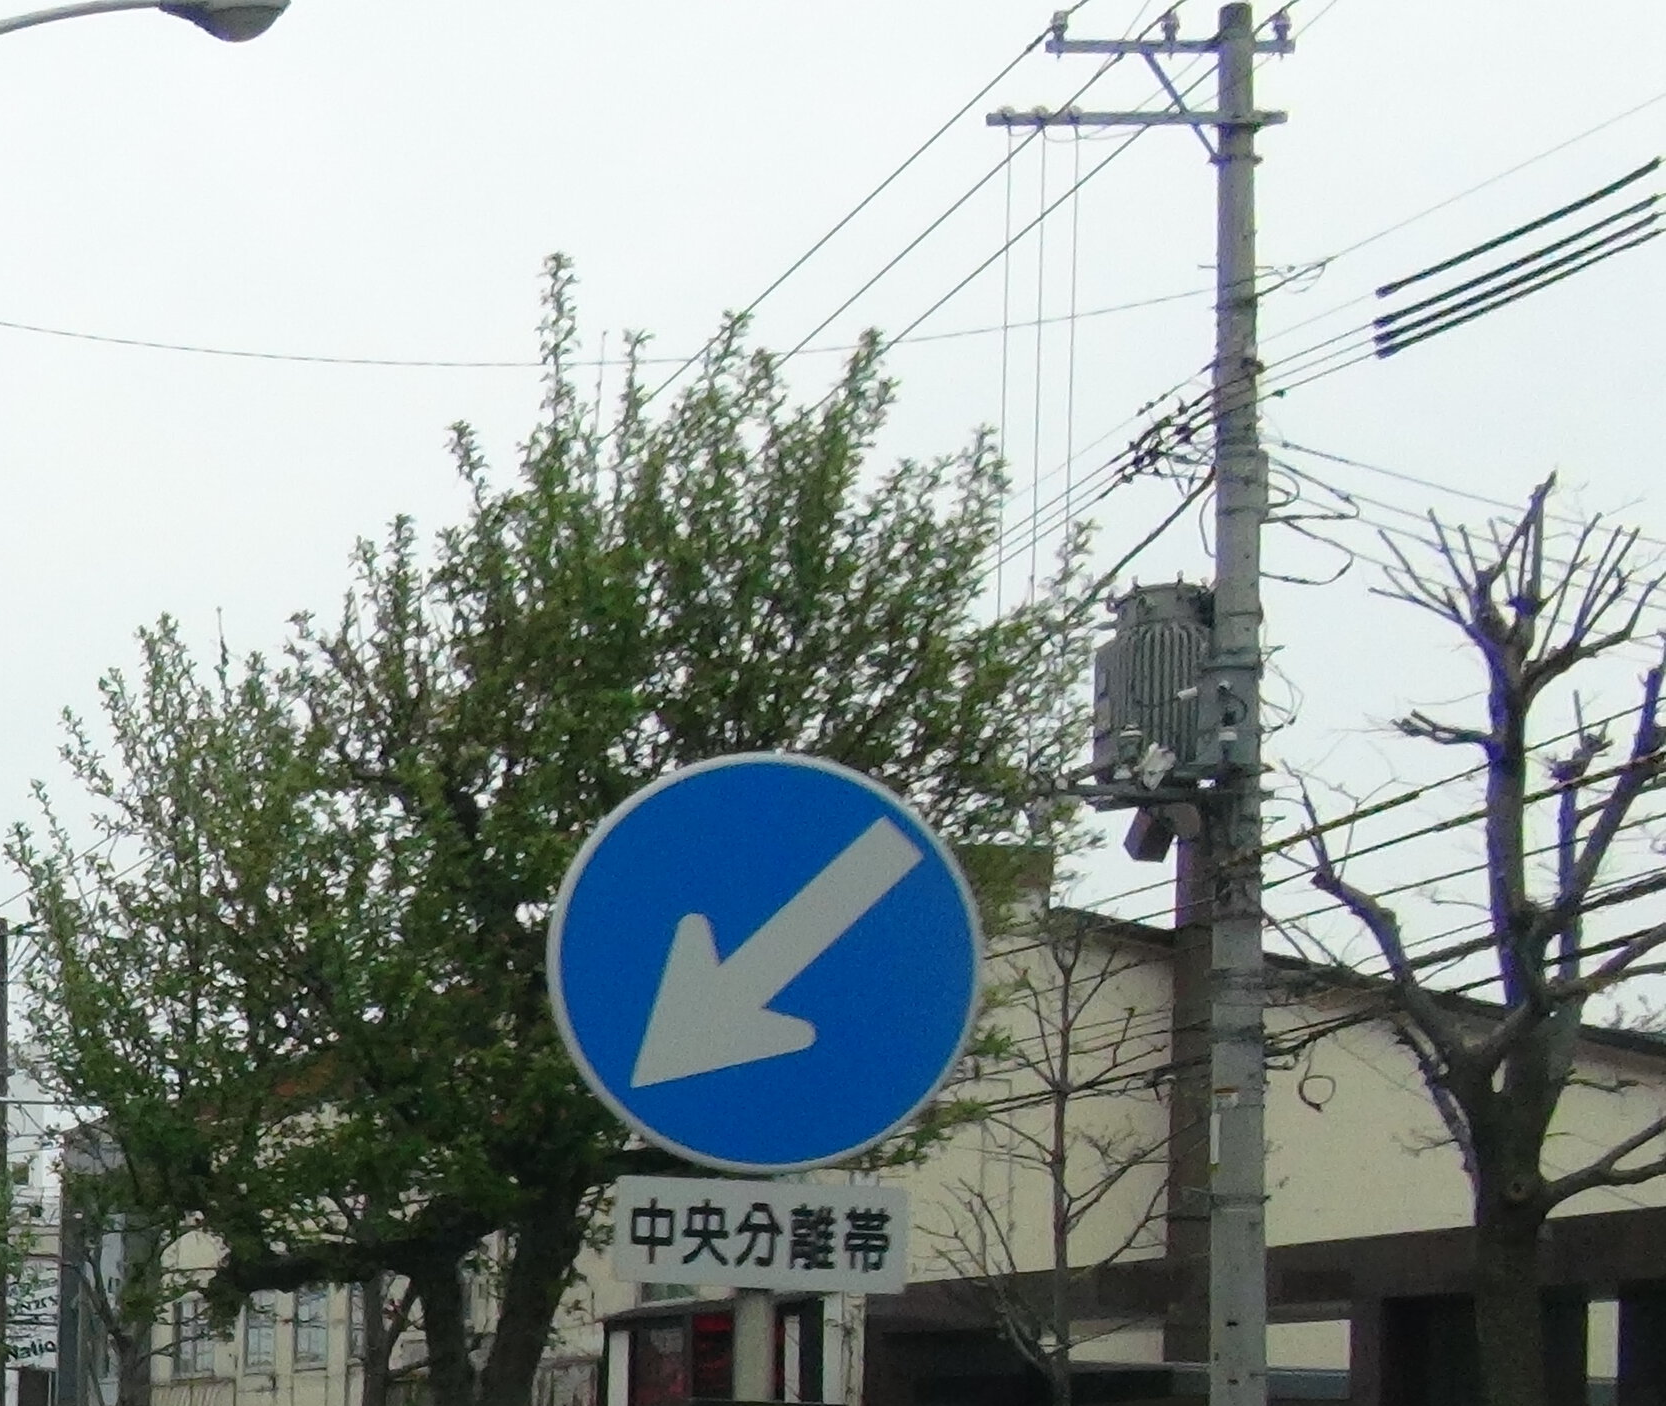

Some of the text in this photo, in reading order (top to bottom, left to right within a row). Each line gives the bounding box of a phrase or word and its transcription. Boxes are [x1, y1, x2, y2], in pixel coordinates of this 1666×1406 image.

[628, 1197, 892, 1273] 中央分離帯
